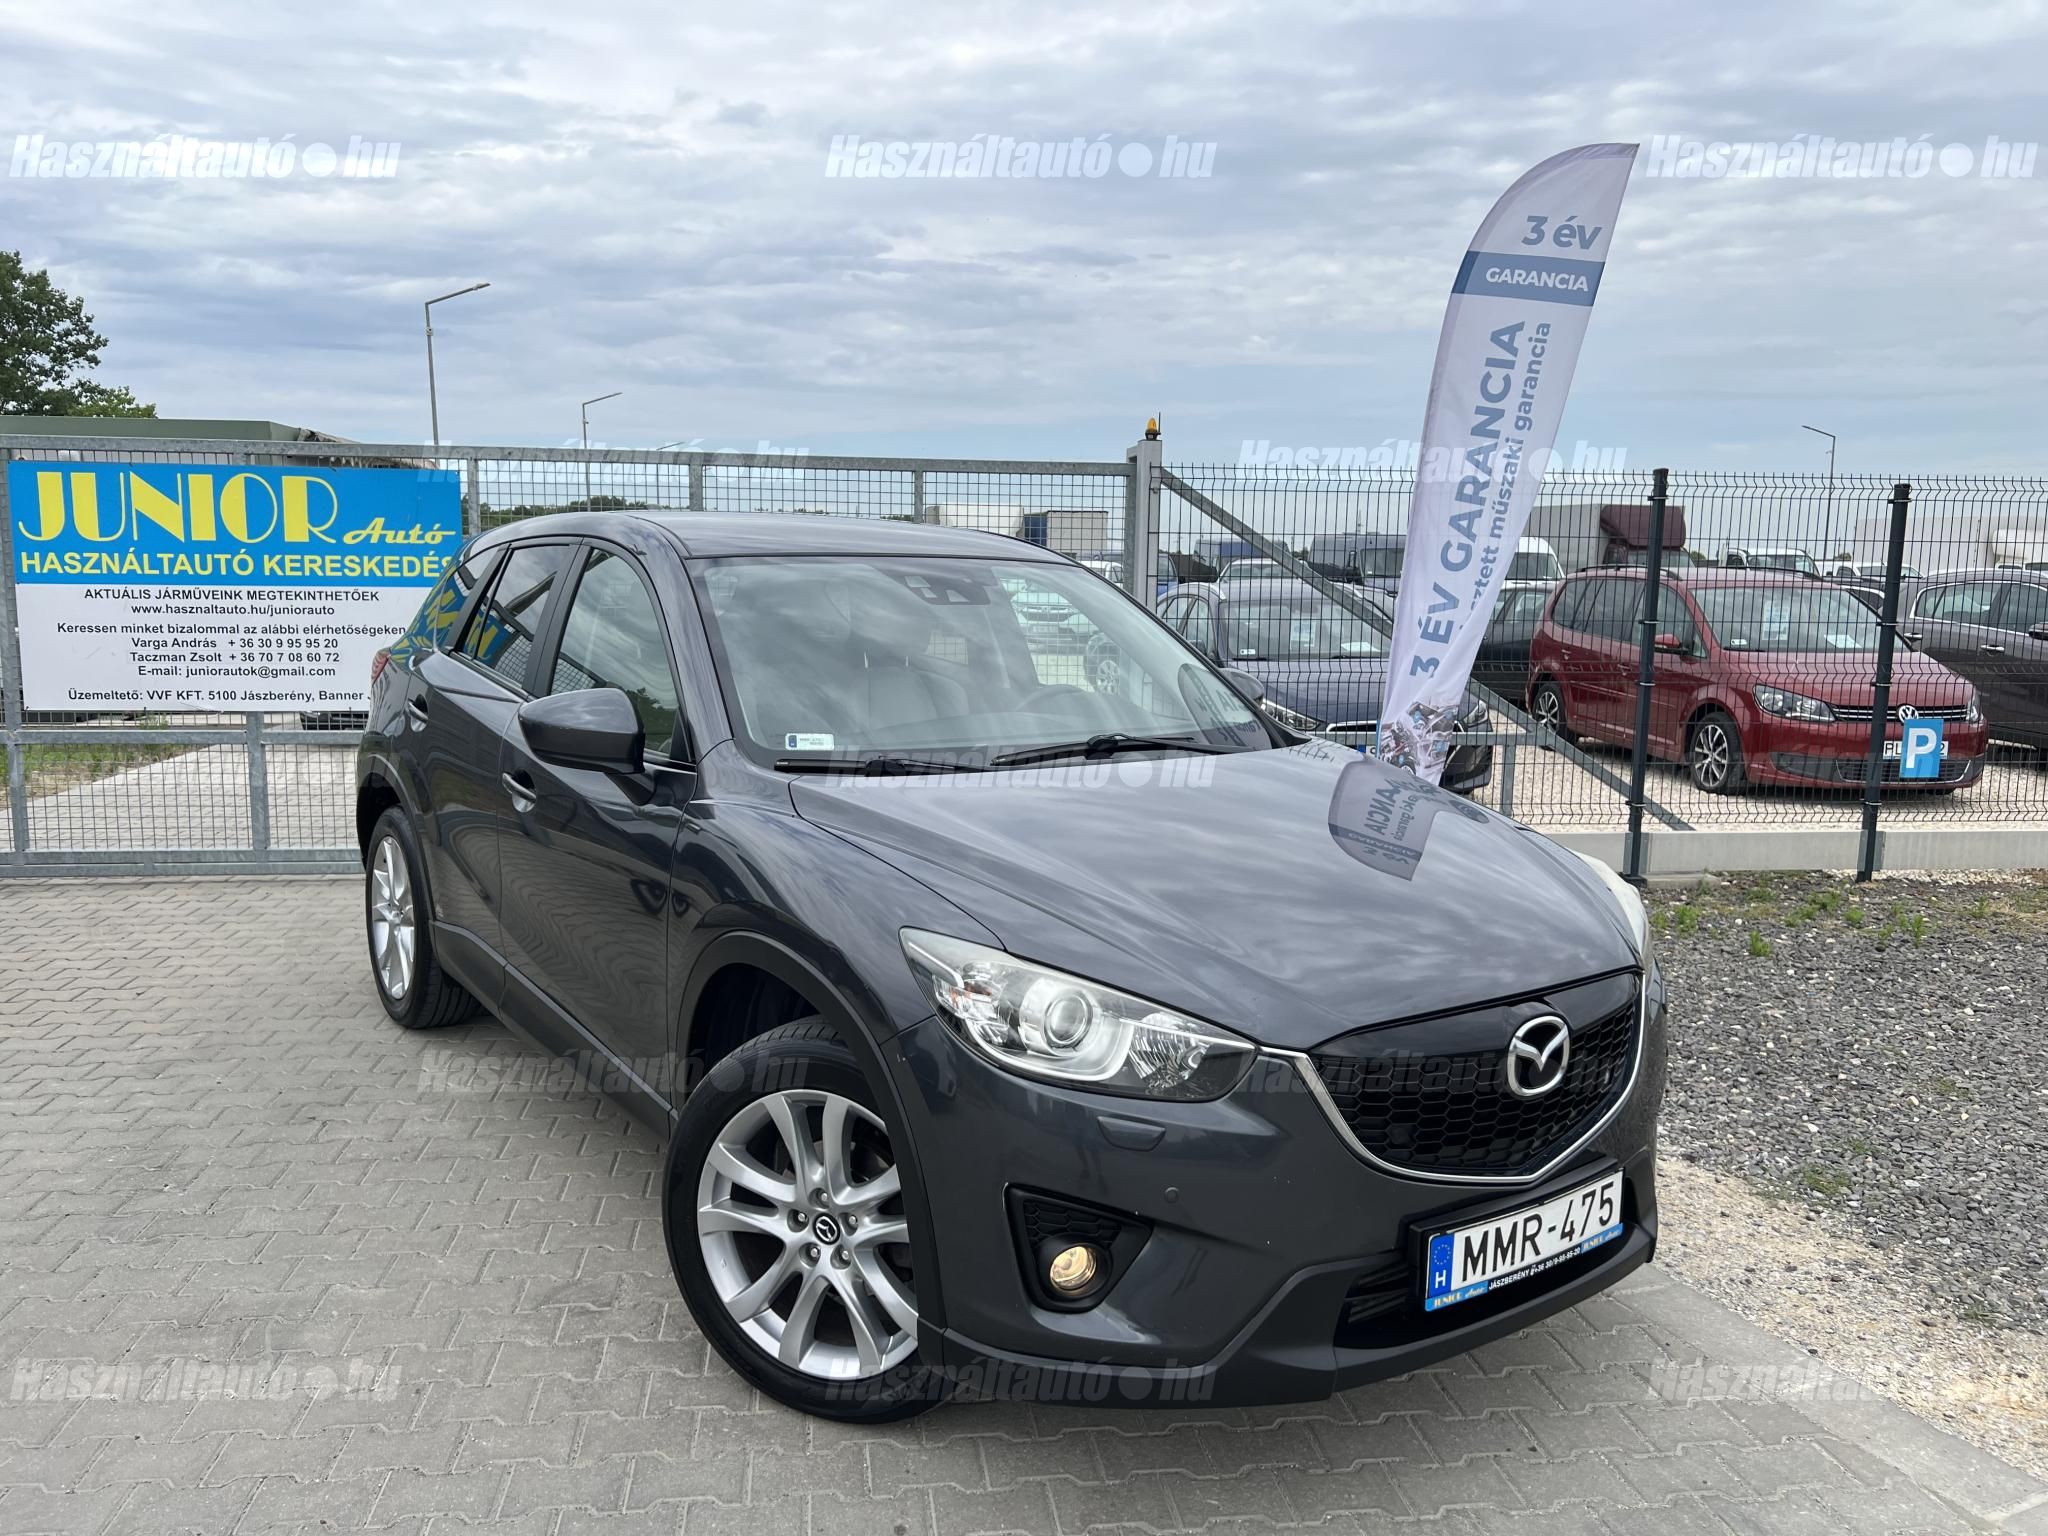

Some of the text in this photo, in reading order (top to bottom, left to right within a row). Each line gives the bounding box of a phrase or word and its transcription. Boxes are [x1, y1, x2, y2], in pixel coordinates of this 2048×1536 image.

[1521, 216, 1602, 250] 3 év
[1486, 267, 1589, 292] GARANCIA
[1490, 437, 1525, 539] műszaki
[1514, 322, 1551, 431] garancia
[18, 471, 456, 545] JUNIOR Autó
[1409, 321, 1526, 678] 3 ÉV GARANCIA
[21, 547, 254, 577] HASZNÁLTAUTÓ
[84, 587, 379, 601] AKTUÁLIS JÁRMŰVEINK MEGTEKINTHETŐEK
[131, 604, 335, 617] www.hasznaltauto.hu/juniorauto
[57, 623, 117, 633] Keressen
[121, 624, 163, 633] minket
[167, 624, 239, 634] bizalommal
[261, 625, 298, 634] alábbi
[303, 625, 406, 636] elérhetőségeken
[131, 638, 168, 649] Varga
[172, 638, 217, 648] András
[240, 639, 254, 648] 36
[258, 639, 272, 648] 30
[276, 639, 283, 648] 9
[287, 639, 302, 648] 95
[305, 639, 320, 648] 95
[324, 639, 338, 648] 20
[130, 652, 186, 662] Taczman
[190, 652, 222, 662] Zsolt
[240, 653, 255, 662] 36
[259, 653, 273, 662] 70
[277, 653, 284, 662] 7
[288, 653, 302, 662] 08
[307, 653, 321, 662] 60
[326, 653, 340, 662] 72
[138, 666, 336, 679] E-mail: juniorautok@gmail.com
[68, 687, 143, 700] Üzemeltető:
[146, 691, 172, 700] VVF
[176, 691, 204, 700] KFT.
[208, 691, 236, 701] 5100
[241, 690, 315, 702] Jászberény,
[319, 691, 364, 700] Banner
[1905, 727, 1938, 769] P
[1462, 1181, 1614, 1283] MMR-475
[1435, 1270, 1447, 1289] H
